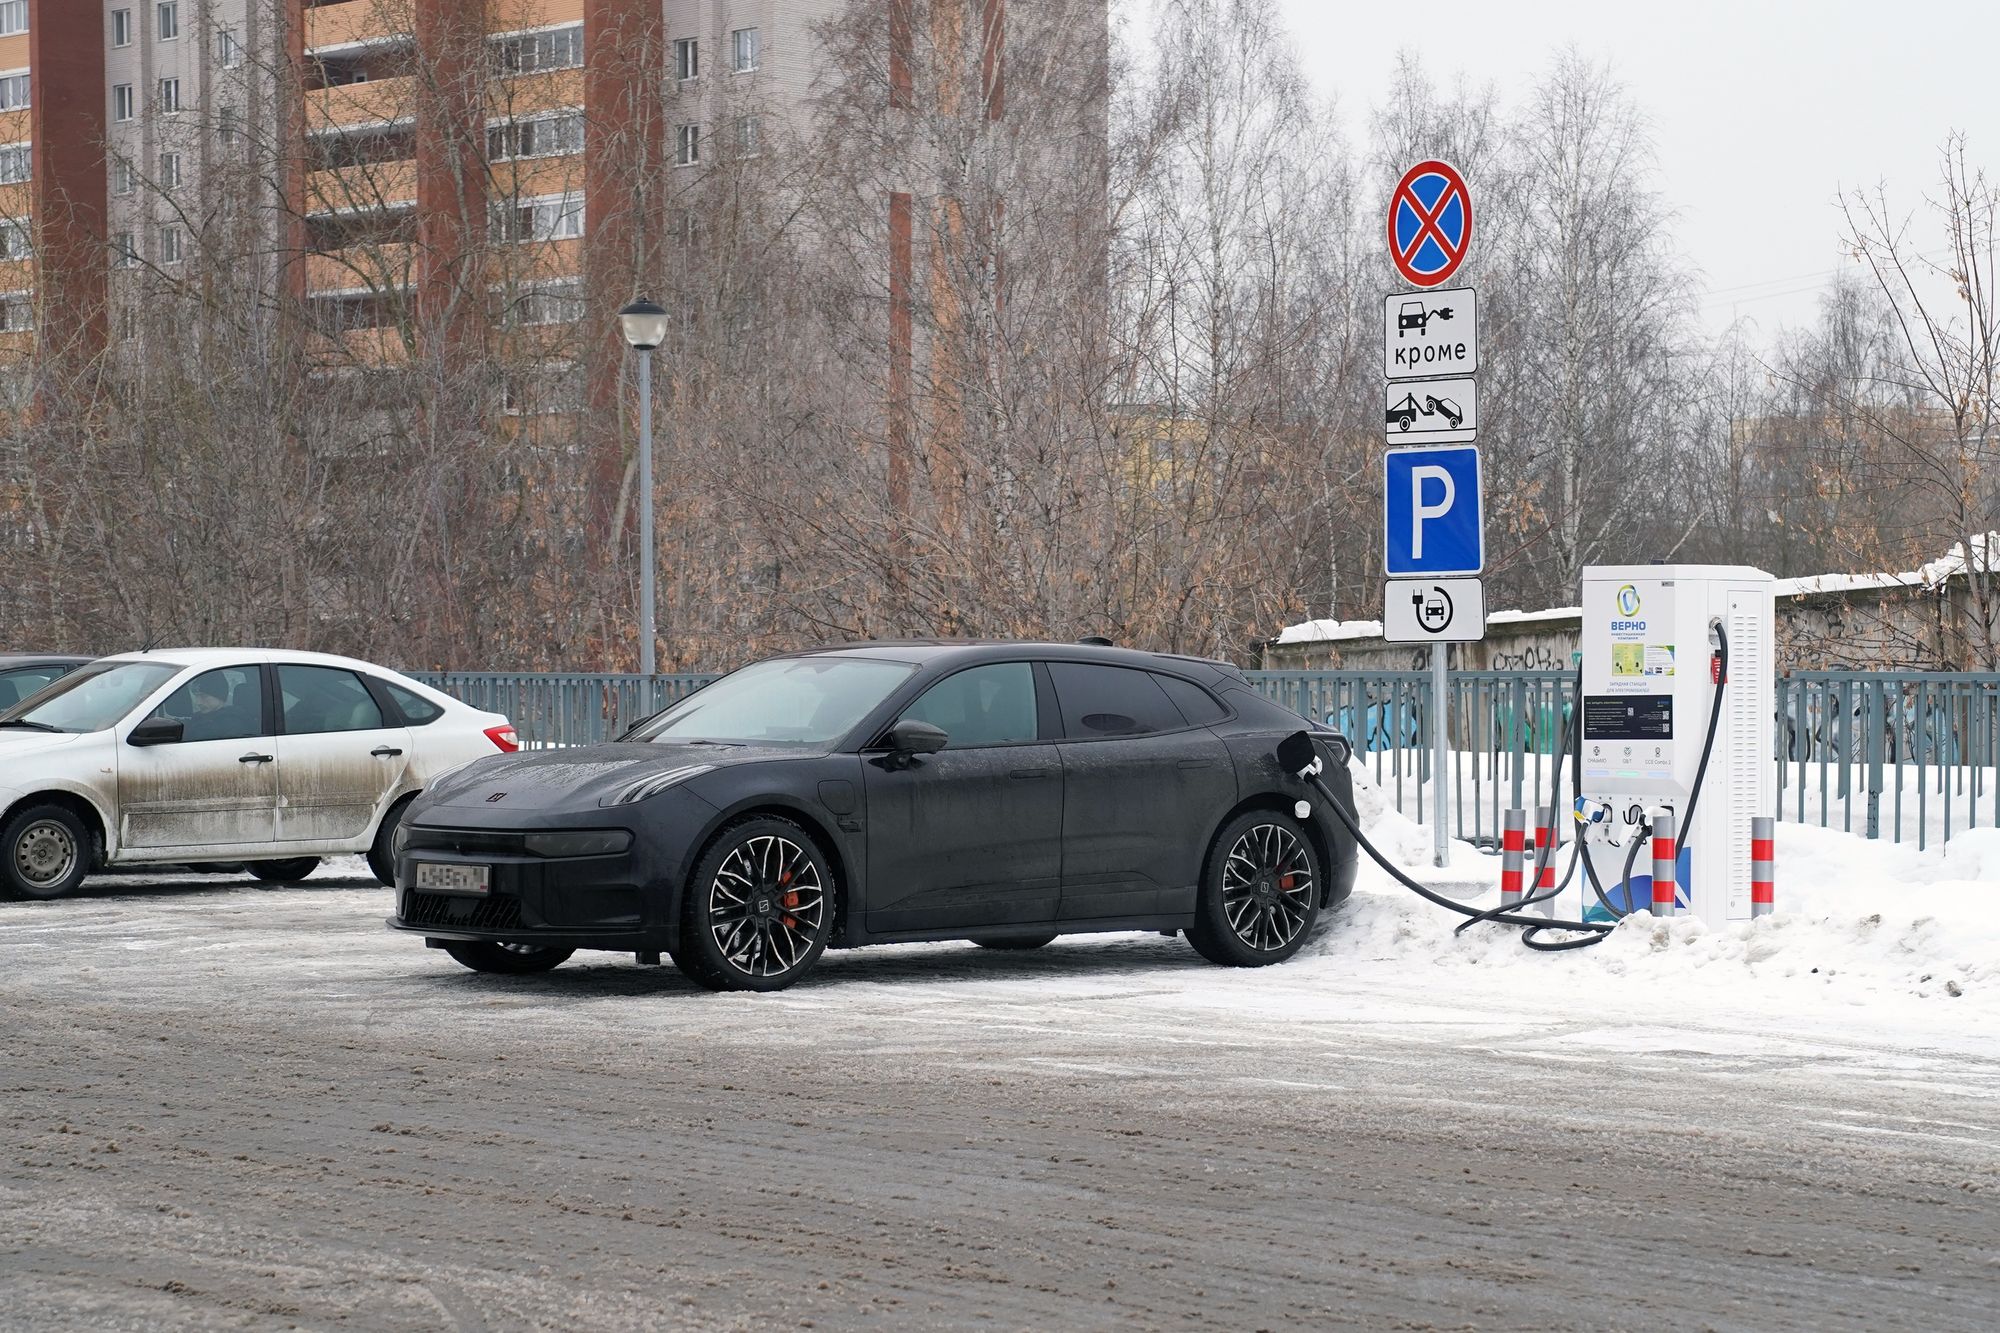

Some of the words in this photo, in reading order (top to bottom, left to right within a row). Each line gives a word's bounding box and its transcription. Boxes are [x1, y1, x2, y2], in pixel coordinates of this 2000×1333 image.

[1395, 343, 1466, 369] кроме
[1412, 465, 1455, 559] P
[1611, 621, 1646, 631] ВЕРНО
